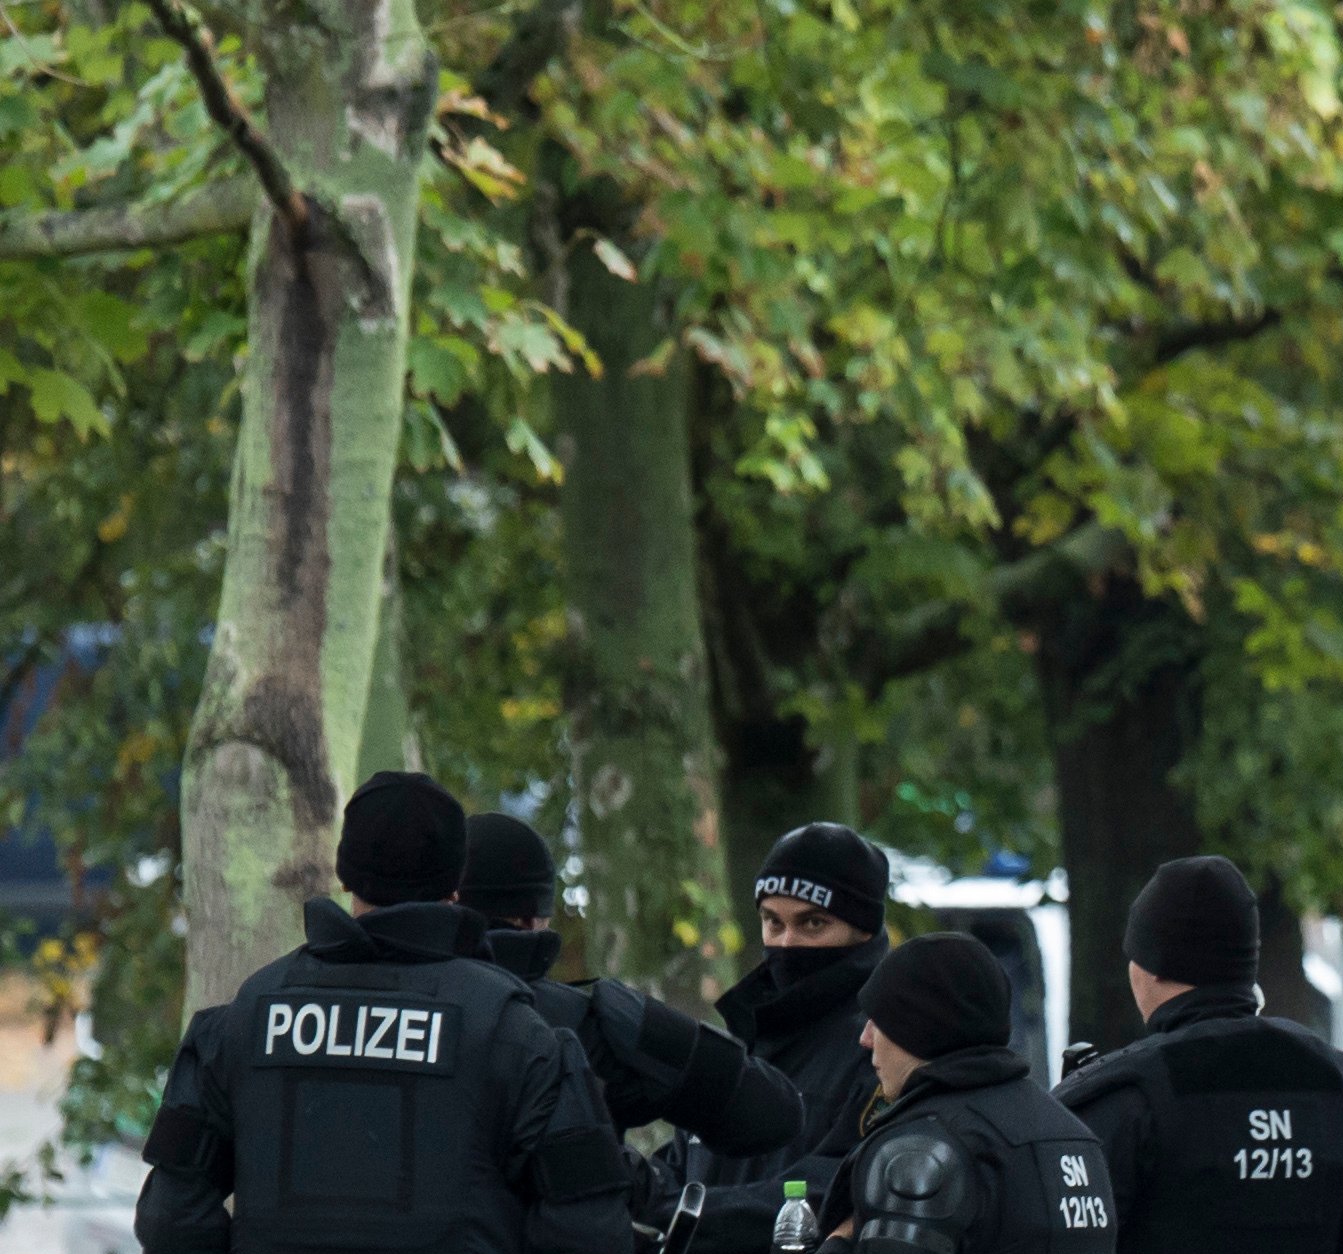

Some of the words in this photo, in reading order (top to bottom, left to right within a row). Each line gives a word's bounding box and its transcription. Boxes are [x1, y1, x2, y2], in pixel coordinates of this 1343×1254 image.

[754, 876, 833, 909] POLIZEI
[265, 1003, 443, 1064] POLIZEI
[1248, 1109, 1292, 1141] SN
[1060, 1154, 1089, 1187] SN
[1233, 1147, 1314, 1181] 12/13
[1059, 1195, 1108, 1229] 12/13
